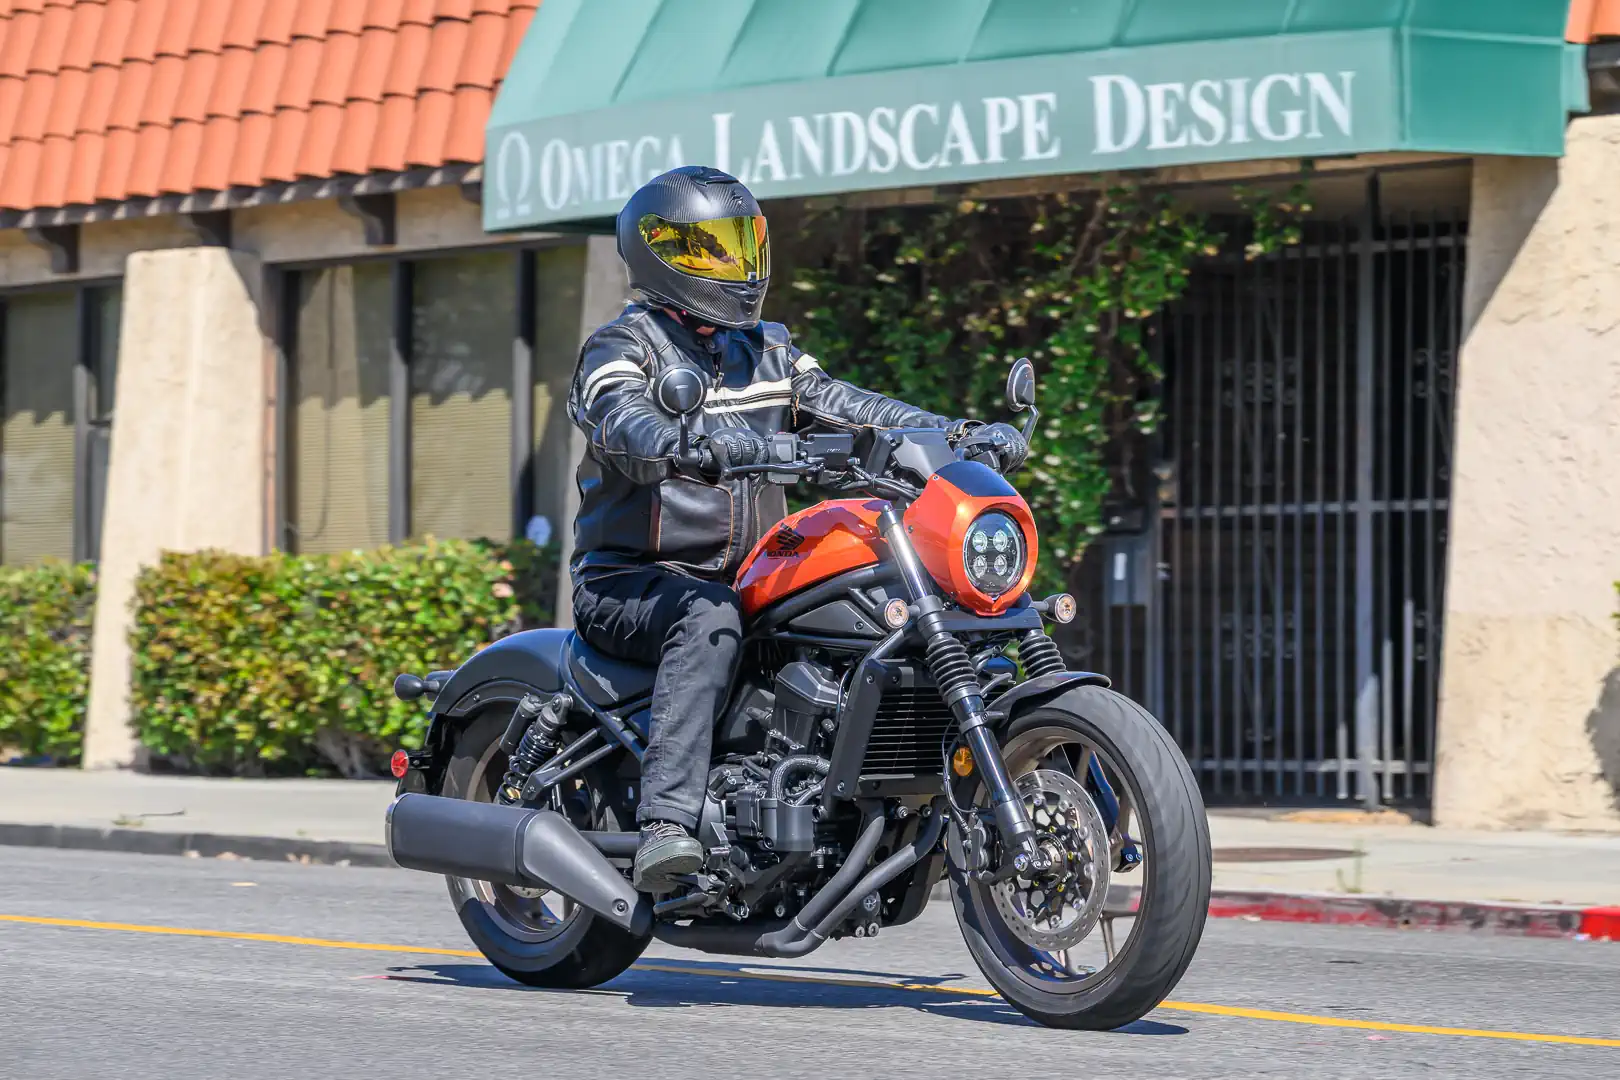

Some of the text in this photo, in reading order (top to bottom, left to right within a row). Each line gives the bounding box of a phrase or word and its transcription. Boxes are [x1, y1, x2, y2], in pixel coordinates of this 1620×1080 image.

[711, 91, 1062, 184] LANDSCAPE
[1088, 70, 1357, 155] DESIGN
[764, 549, 800, 558] HONDA
